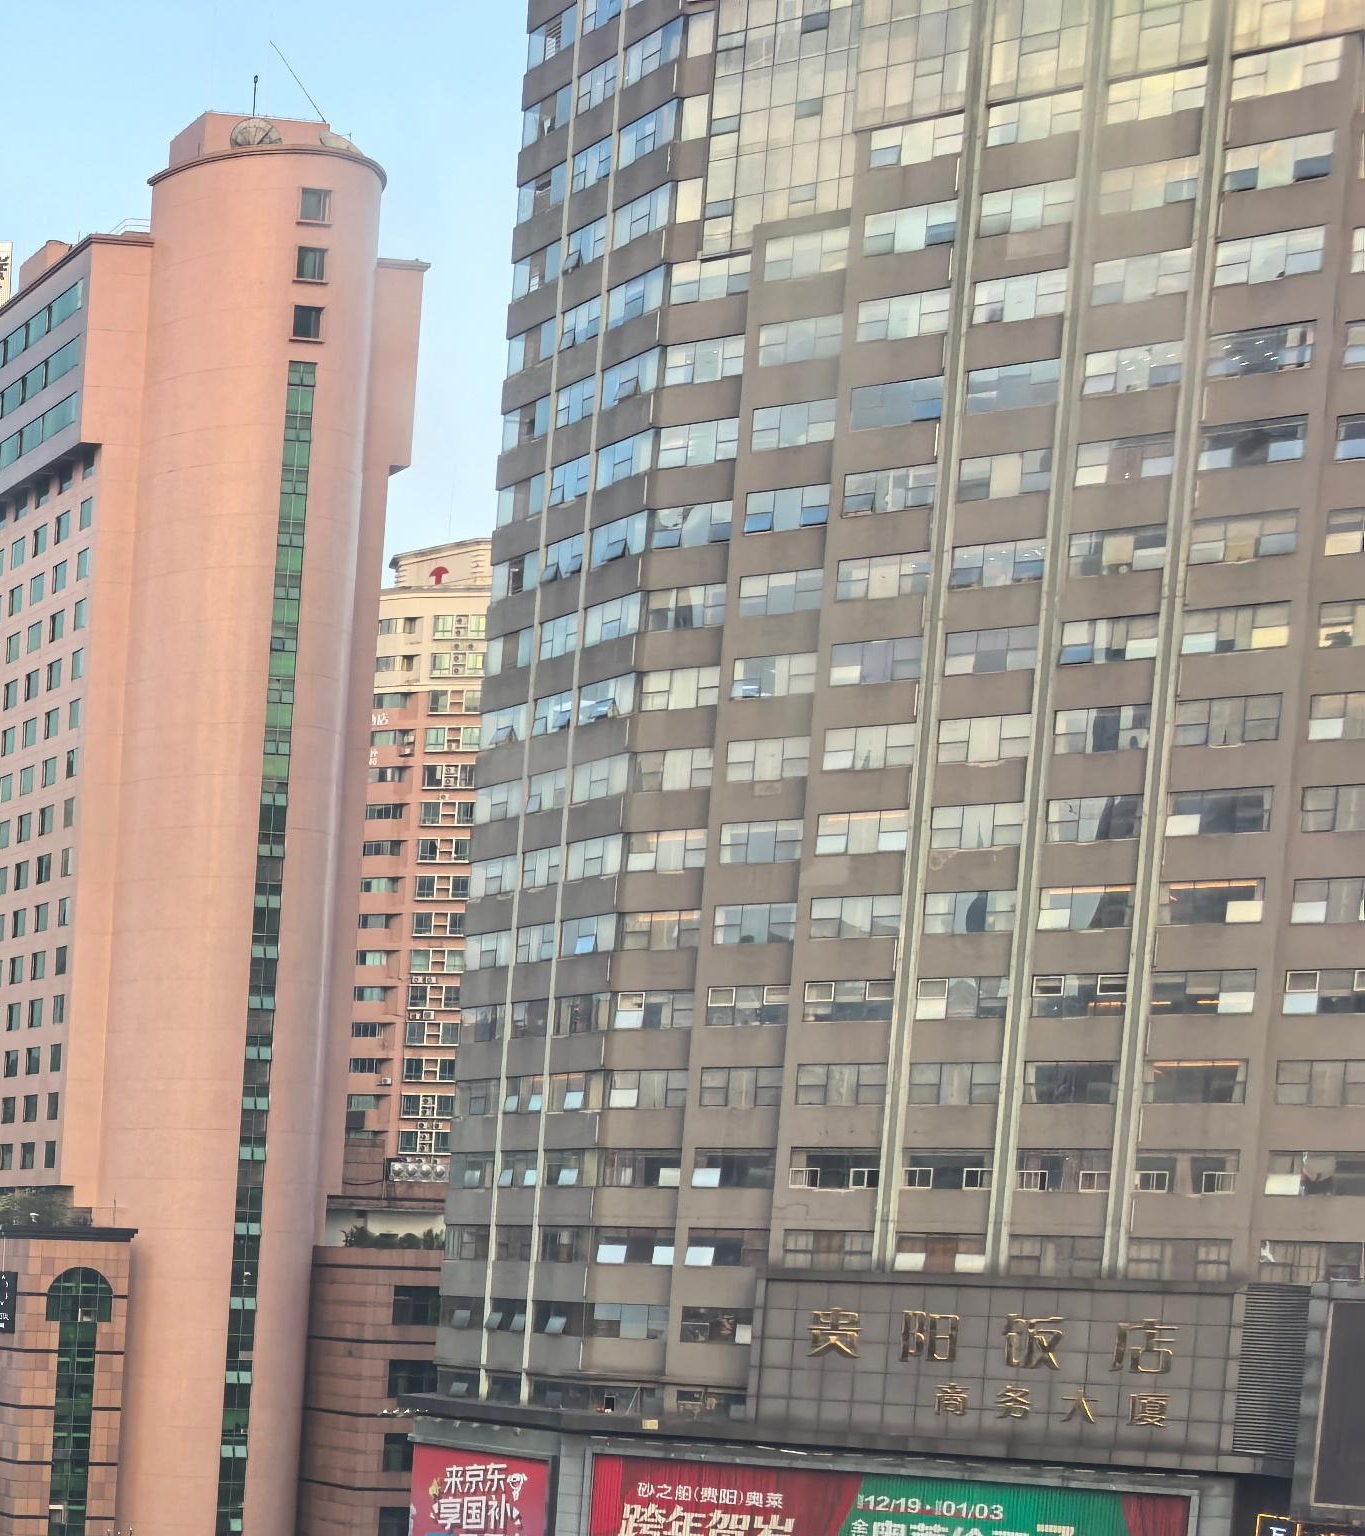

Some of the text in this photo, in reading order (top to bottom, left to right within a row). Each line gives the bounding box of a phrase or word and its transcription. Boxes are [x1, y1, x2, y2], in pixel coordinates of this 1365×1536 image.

[806, 1306, 1179, 1376] 贵阳饭店
[933, 1383, 1169, 1429] 商务大厦
[443, 1462, 508, 1494] 来京东
[437, 1494, 511, 1530] 享国补
